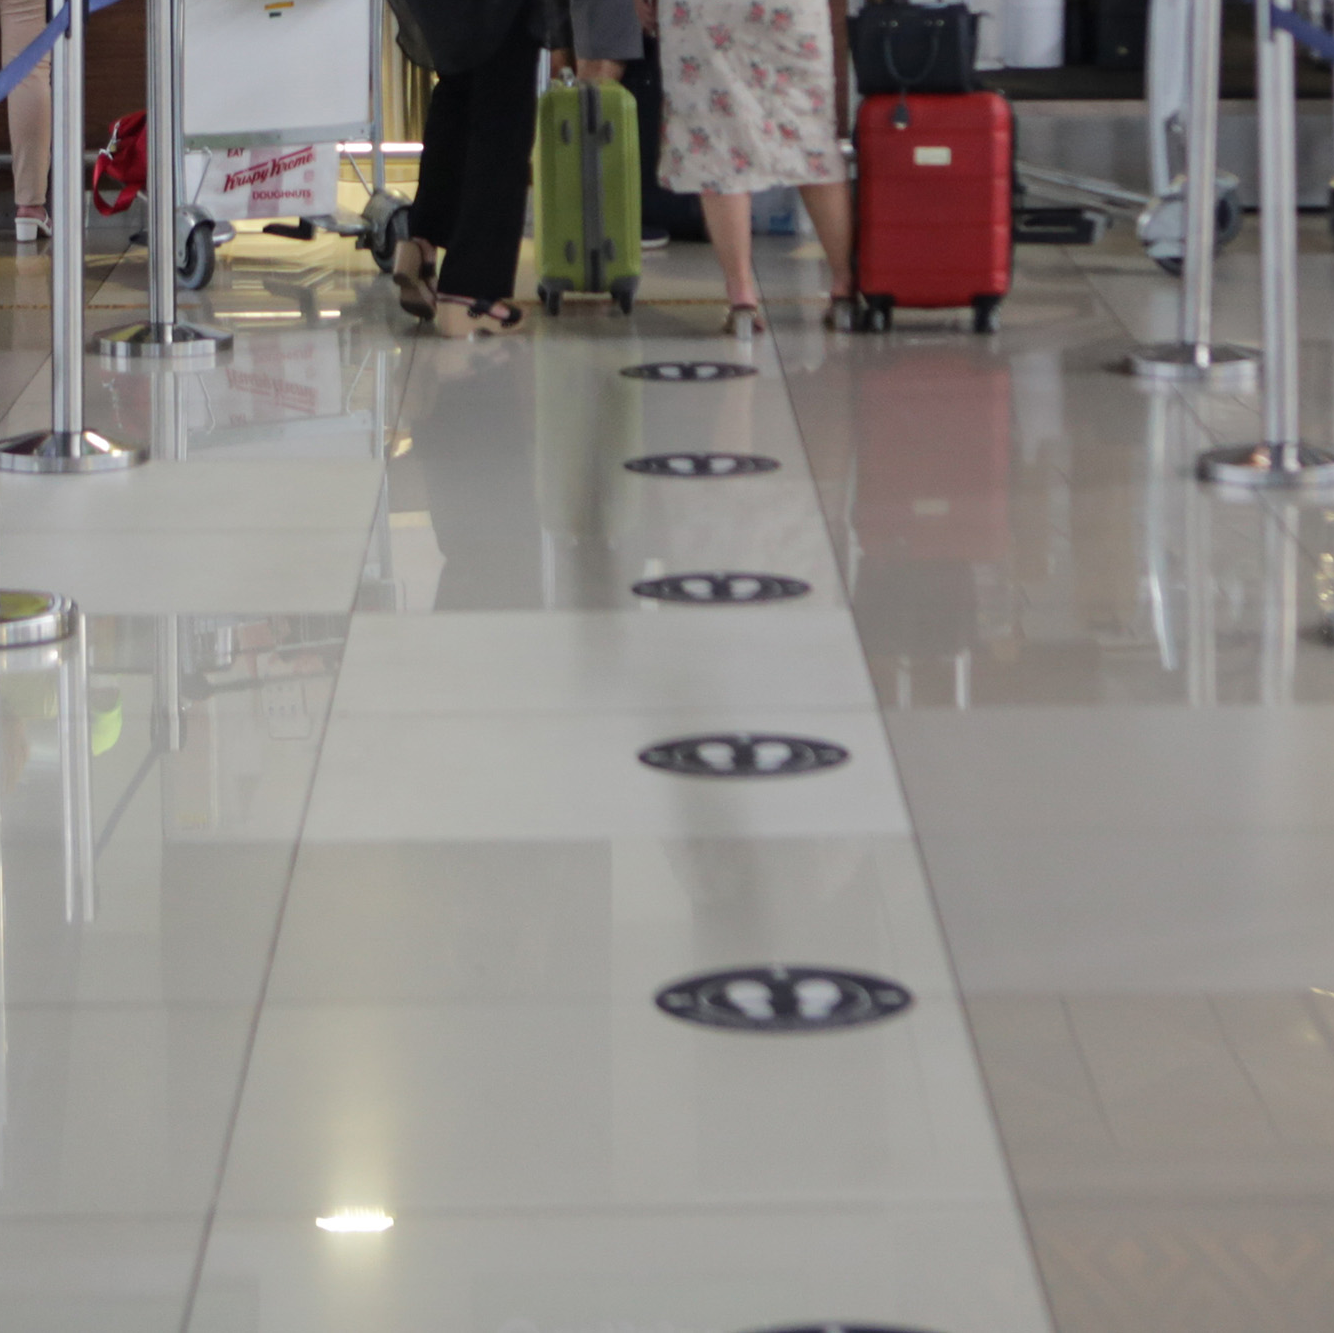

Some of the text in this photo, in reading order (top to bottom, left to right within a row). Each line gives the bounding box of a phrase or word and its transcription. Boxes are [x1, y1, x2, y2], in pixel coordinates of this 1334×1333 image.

[227, 148, 245, 158] EAT
[223, 149, 313, 193] Krispy Kreme
[253, 189, 312, 200] DOUGHNUTS
